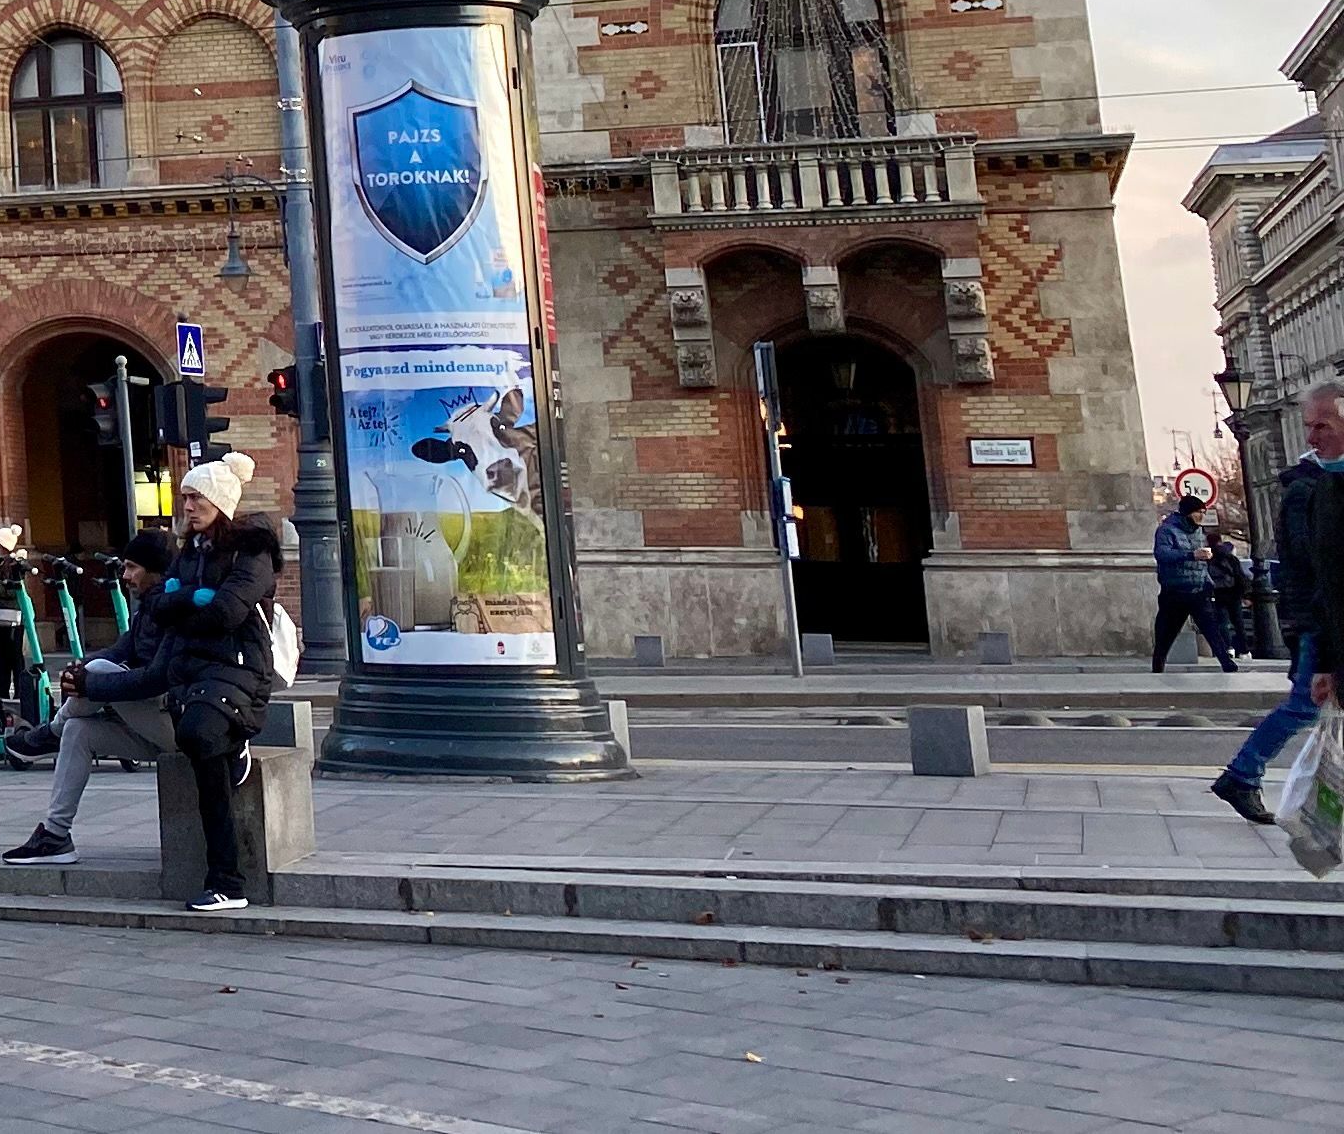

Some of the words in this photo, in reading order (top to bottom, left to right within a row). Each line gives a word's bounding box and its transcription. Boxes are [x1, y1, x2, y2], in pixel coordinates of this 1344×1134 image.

[388, 129, 441, 145] PAJZS
[409, 150, 423, 164] A
[367, 169, 470, 187] TOROKNAK!
[345, 362, 409, 379] Fogyaszd
[411, 359, 509, 376] mindennap!
[349, 408, 356, 418] A
[358, 406, 377, 421] tej?
[358, 419, 372, 430] Az
[1183, 480, 1192, 495] 5
